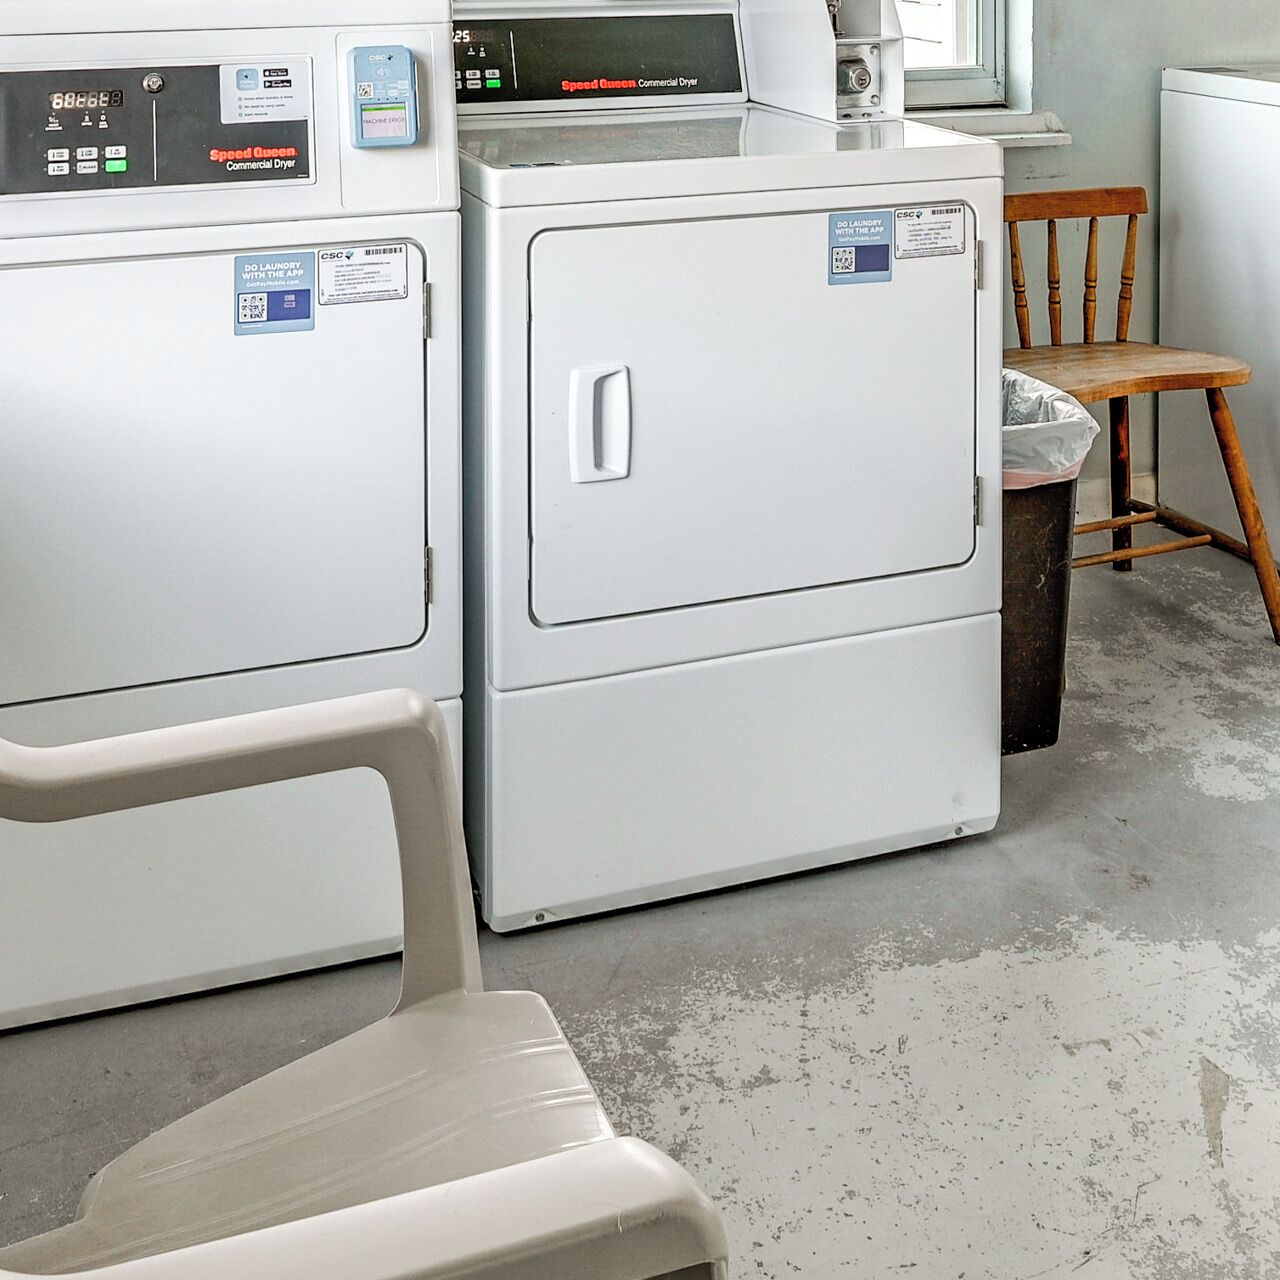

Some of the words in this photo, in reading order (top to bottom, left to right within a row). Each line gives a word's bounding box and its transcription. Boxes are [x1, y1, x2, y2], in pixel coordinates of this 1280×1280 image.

[561, 79, 599, 92] Speed
[638, 77, 678, 88] Commercial
[679, 77, 698, 88] Dryer
[209, 147, 252, 162] Speed
[226, 159, 272, 171] Commercial
[274, 159, 296, 170] Dryer
[849, 219, 882, 227] LAUNDRY
[321, 252, 343, 260] CSC
[244, 264, 258, 272] DO
[260, 261, 301, 271] LAUNDRY
[241, 272, 265, 280] WITH
[267, 270, 285, 278] THE
[286, 269, 304, 277] APP
